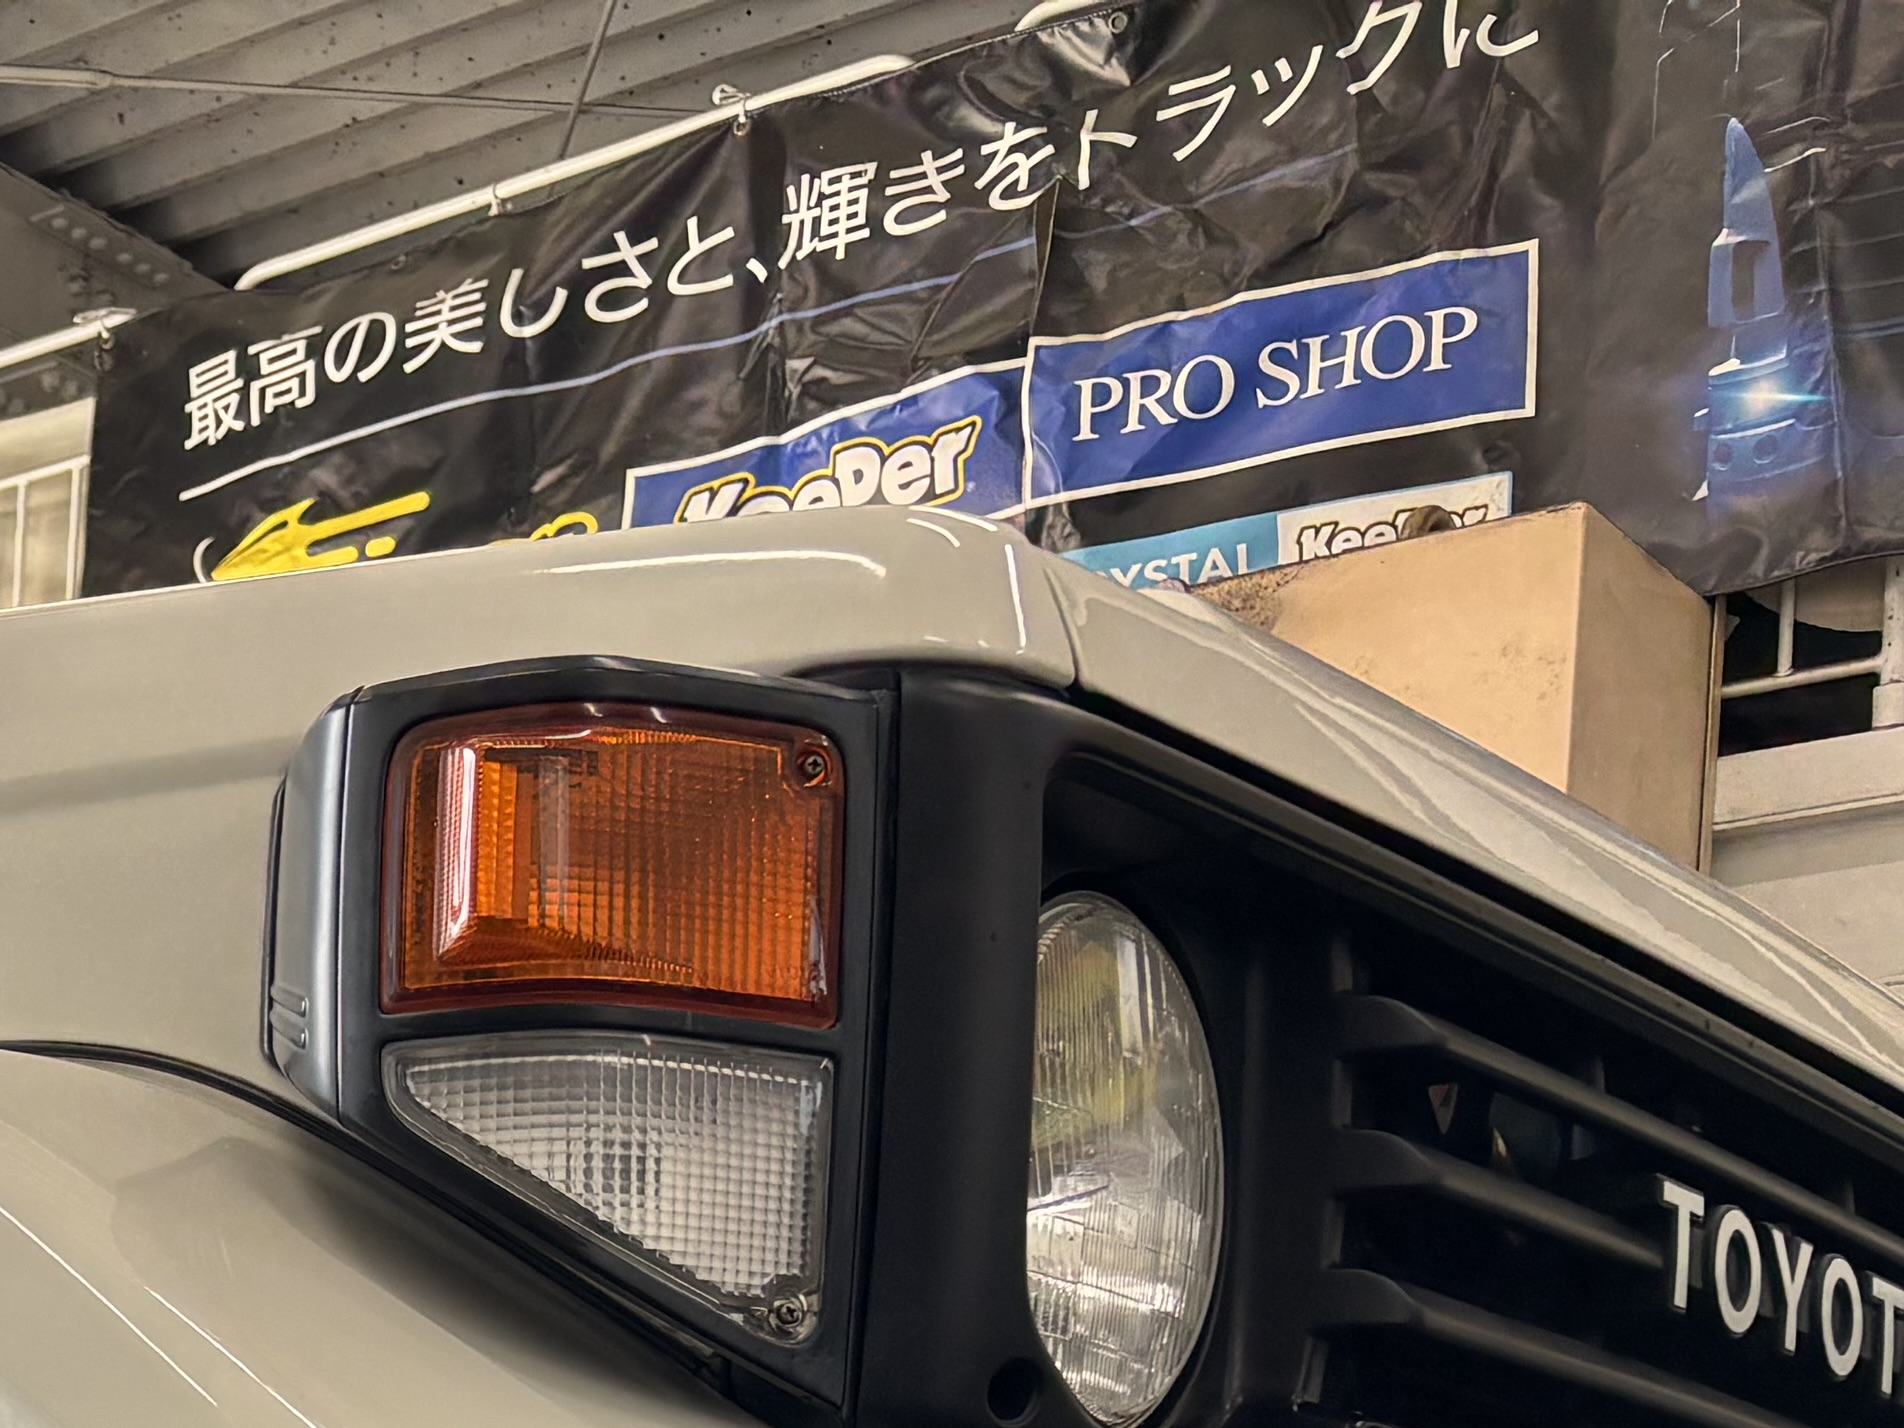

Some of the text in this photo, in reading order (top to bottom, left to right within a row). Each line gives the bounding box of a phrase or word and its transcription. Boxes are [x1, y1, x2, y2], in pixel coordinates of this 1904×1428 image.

[184, 0, 1539, 450] 最高の美しさと、輝きをトラックに
[1072, 306, 1478, 442] PRO SHOP
